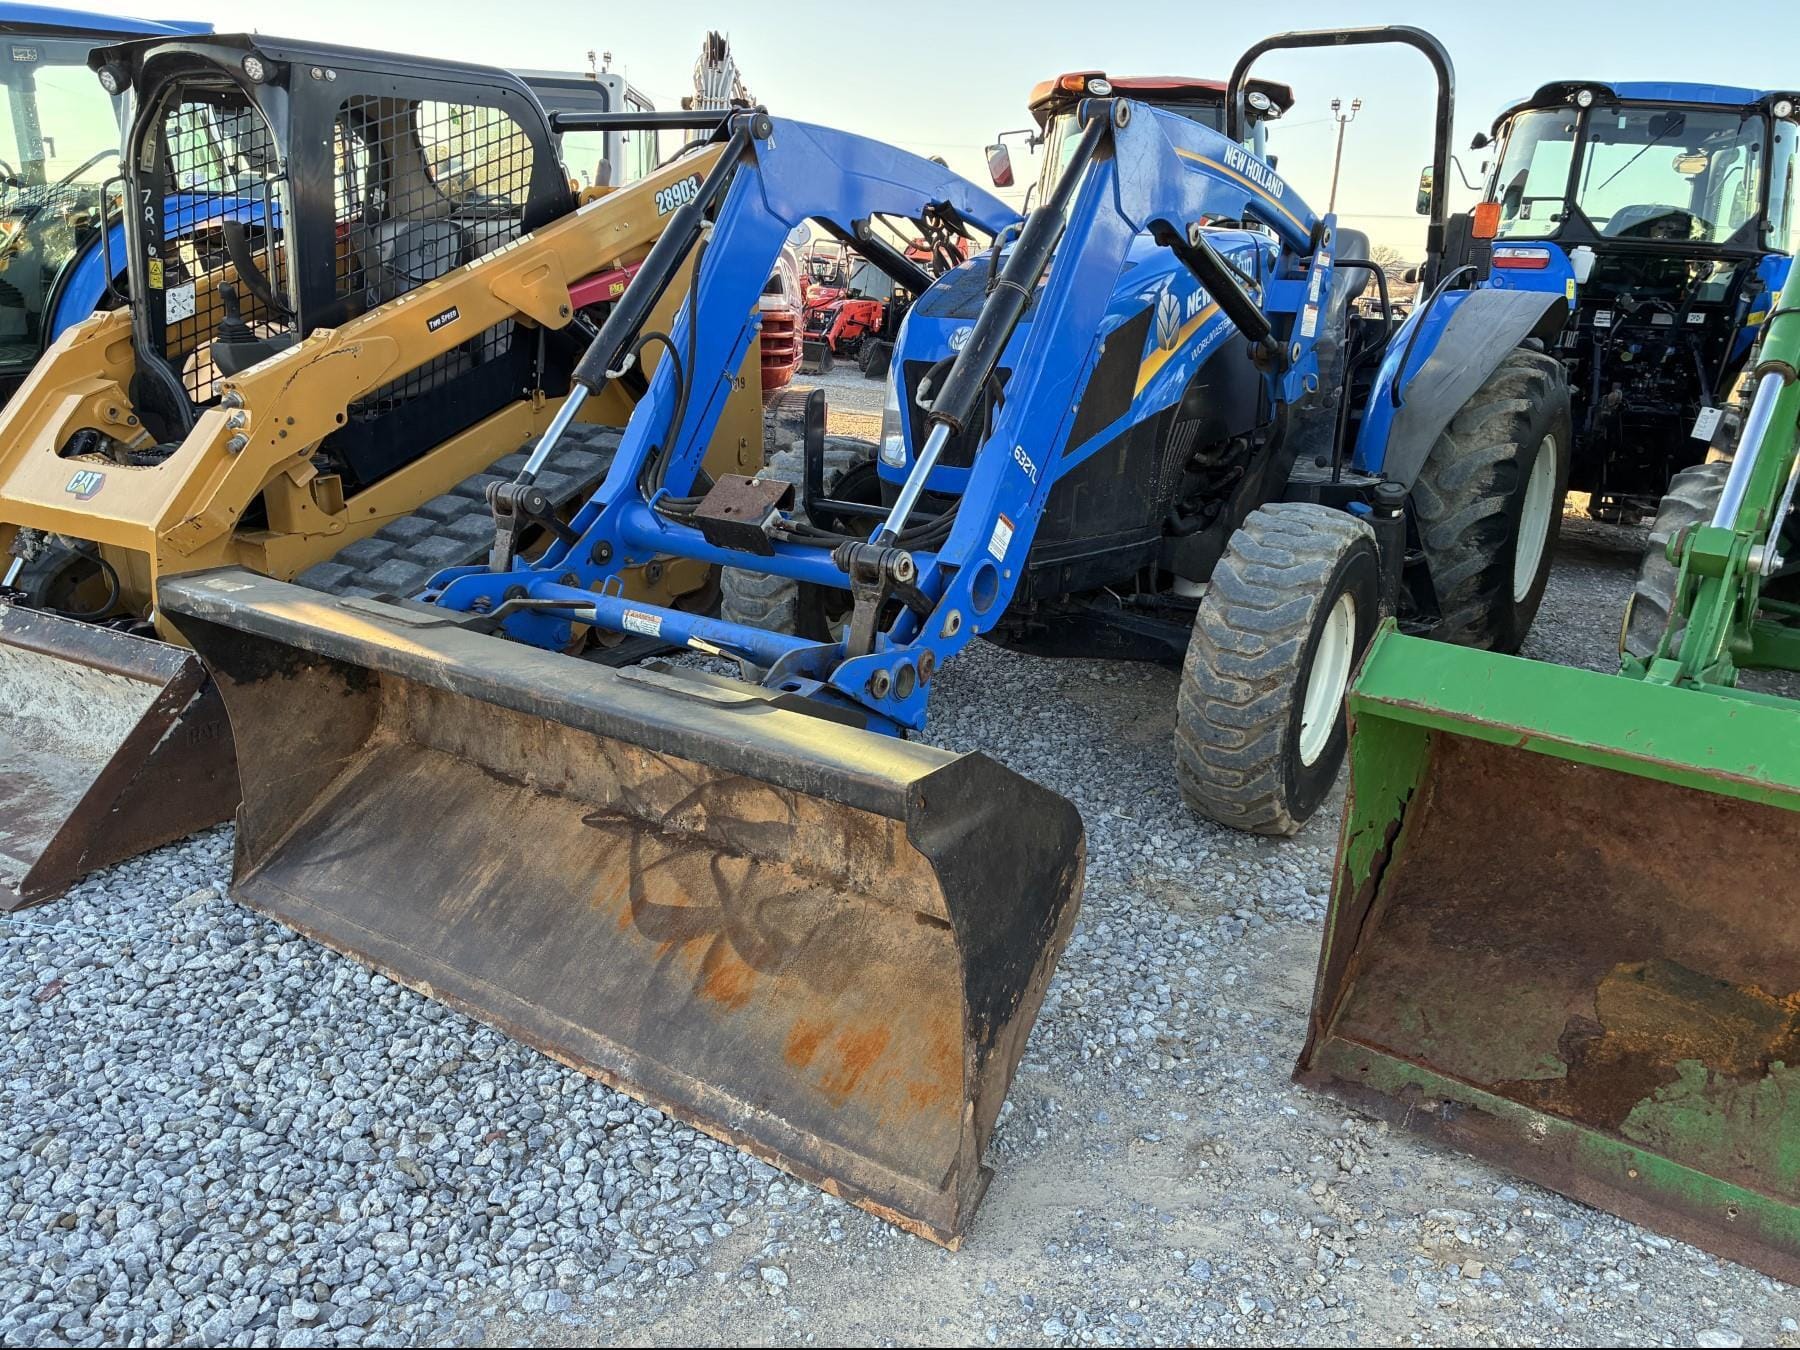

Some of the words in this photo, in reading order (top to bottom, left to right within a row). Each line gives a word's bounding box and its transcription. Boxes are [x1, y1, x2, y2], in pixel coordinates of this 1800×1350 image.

[1223, 144, 1247, 172] NEW
[1244, 157, 1284, 199] HOLLAND
[655, 174, 699, 216] 289D3
[66, 469, 103, 495] CAT
[1014, 444, 1038, 485] 632TL
